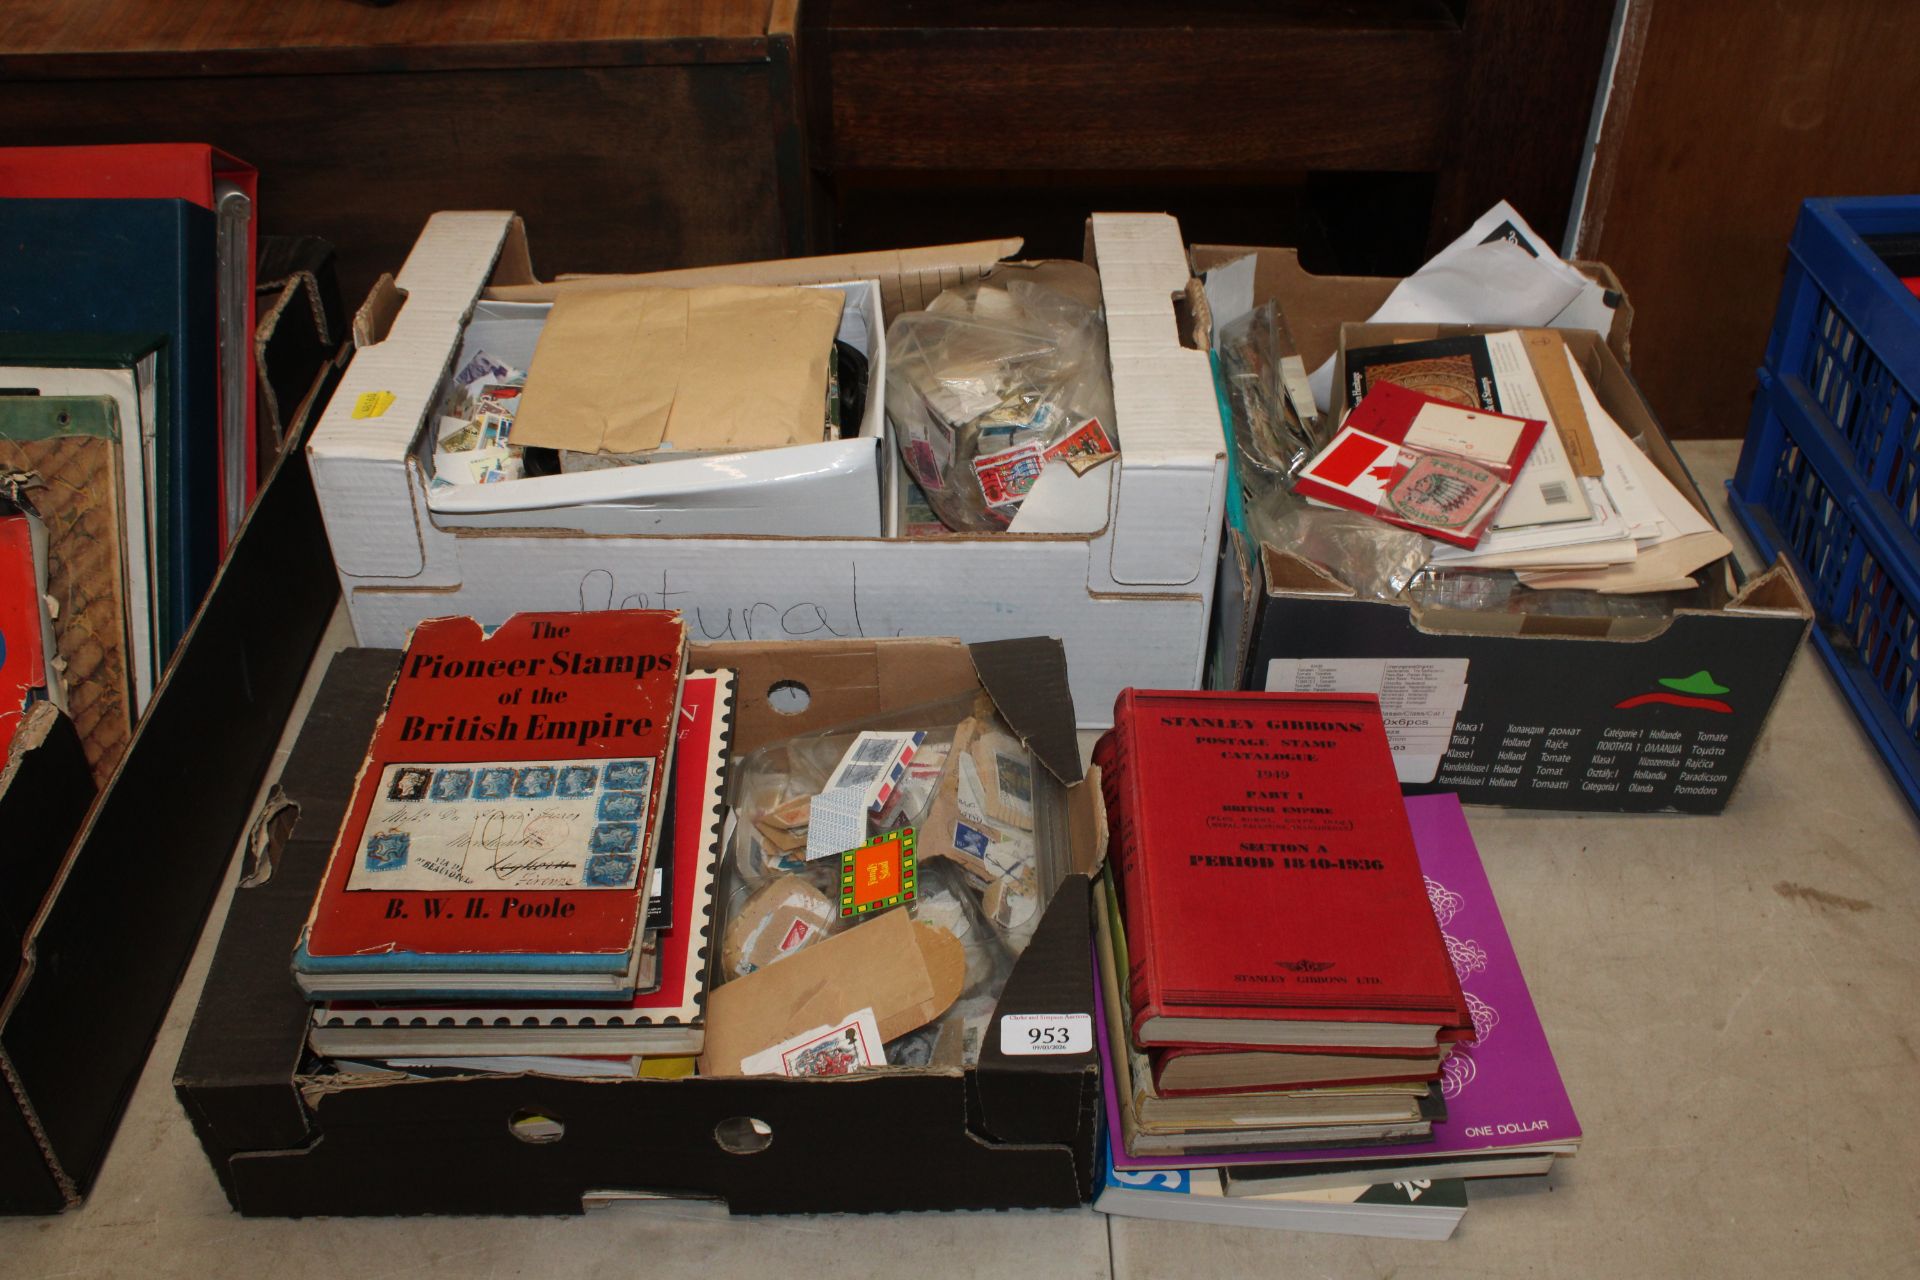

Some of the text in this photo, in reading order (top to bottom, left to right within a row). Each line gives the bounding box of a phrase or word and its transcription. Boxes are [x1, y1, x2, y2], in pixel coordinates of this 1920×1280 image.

[530, 621, 570, 639] The
[408, 649, 673, 680] Pioneer Stamps
[498, 687, 568, 706] of the
[400, 714, 517, 742] British
[522, 712, 653, 746] Empire
[1160, 716, 1254, 730] STANLEY
[1649, 729, 1682, 740] Hollande
[1697, 731, 1728, 742] Tomate
[1195, 737, 1337, 749] POSTAGE STAMP
[1502, 738, 1531, 747] Holland
[1220, 751, 1318, 762] CATALOGUE
[1447, 749, 1470, 759] Klasse
[1497, 751, 1527, 761] Holland
[1540, 752, 1571, 762] Tomate
[1592, 754, 1611, 764] Klasa
[1256, 769, 1289, 780] 1949
[1493, 764, 1522, 774] Holland
[1536, 765, 1563, 776] Tomat
[1633, 770, 1667, 780] Hollandia
[1680, 771, 1727, 782] Paradicsom
[1488, 777, 1517, 787] Holland
[1531, 778, 1569, 789] Tomaatti
[1582, 781, 1615, 792] Categoria
[1628, 783, 1654, 793] Olanda
[1674, 785, 1718, 795] Pomodoro
[1246, 790, 1289, 800] PART
[1222, 804, 1333, 815] BRITISH EMPIRE
[1240, 842, 1328, 853] SECTION A
[1189, 855, 1384, 871] PERIOD 1840-1936
[384, 897, 576, 919] B. W. H. Poole
[1234, 975, 1286, 984] STANLEY
[1297, 976, 1347, 985] GIBBONS
[1028, 1026, 1070, 1044] 953
[1464, 1120, 1549, 1138] ONE DOLLAR
